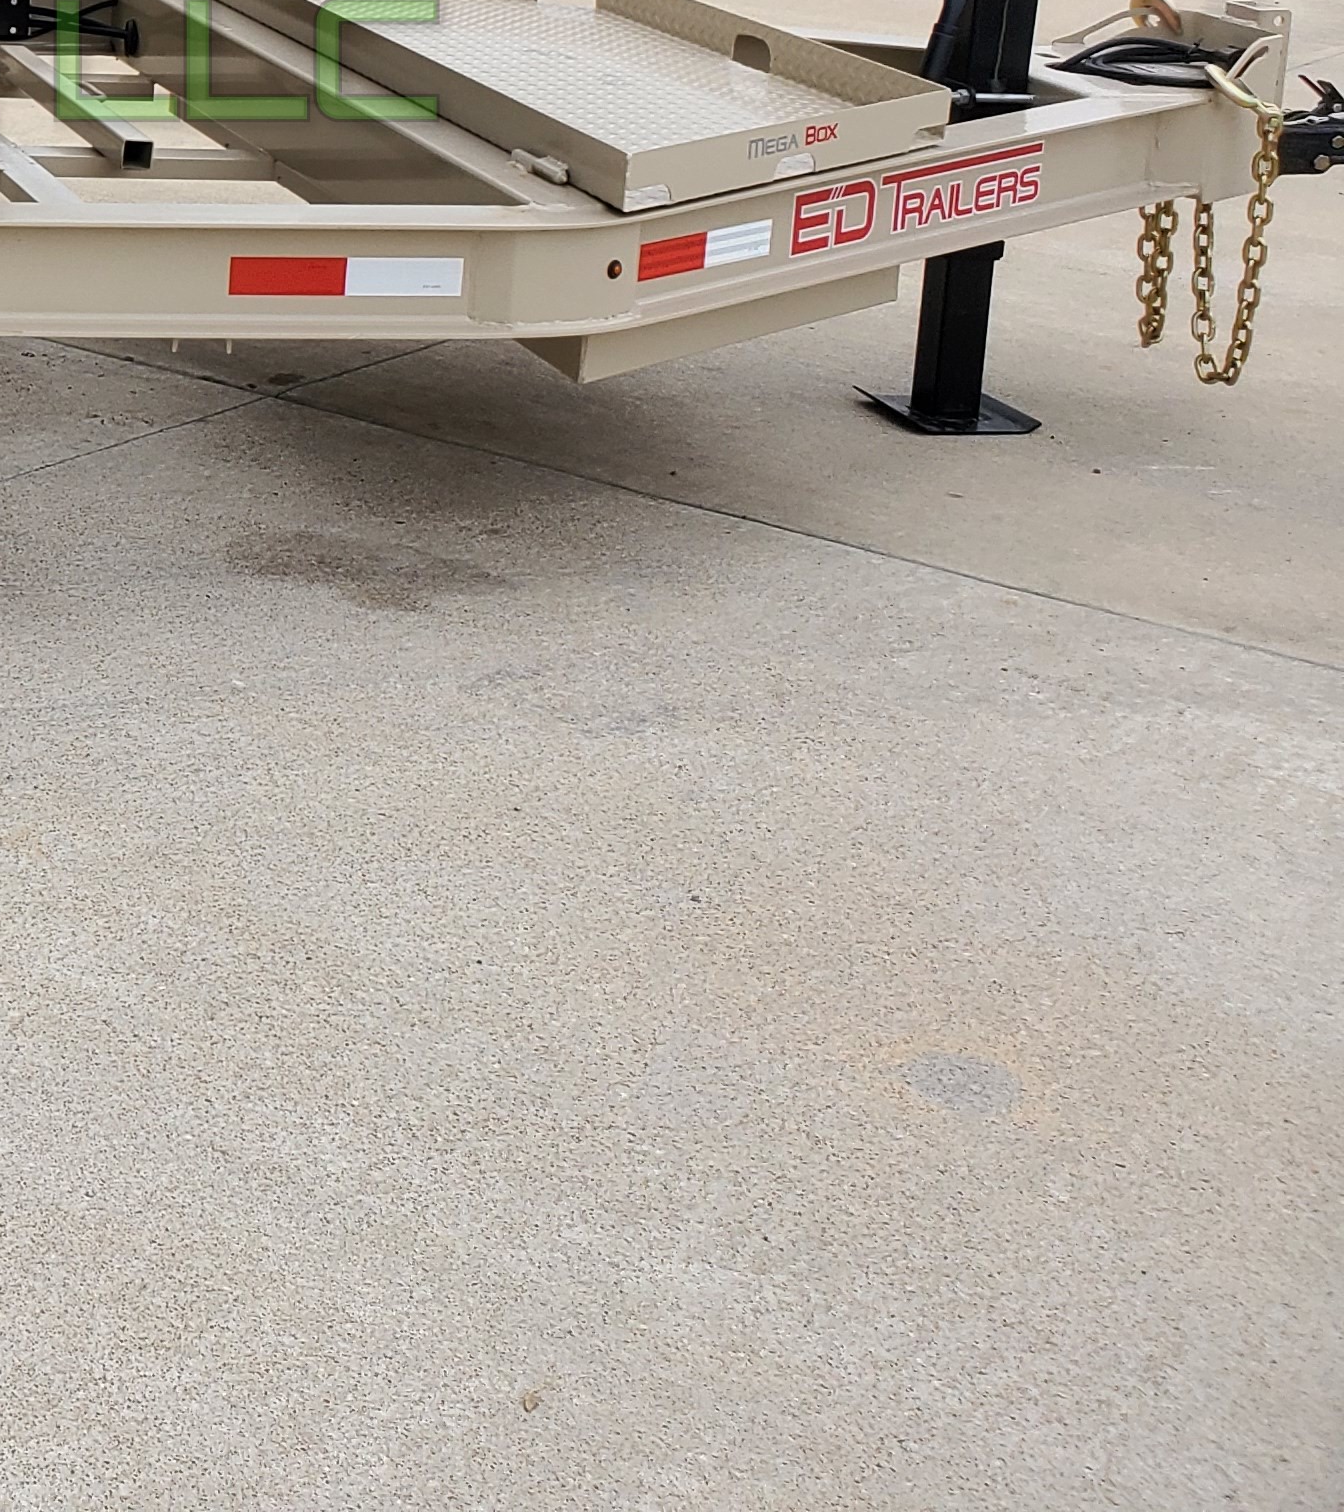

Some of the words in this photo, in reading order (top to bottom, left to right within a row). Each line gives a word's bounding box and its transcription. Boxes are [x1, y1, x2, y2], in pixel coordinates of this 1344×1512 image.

[747, 134, 798, 160] MEGA
[790, 177, 877, 258] ED
[882, 141, 1045, 233] TRAILERS
